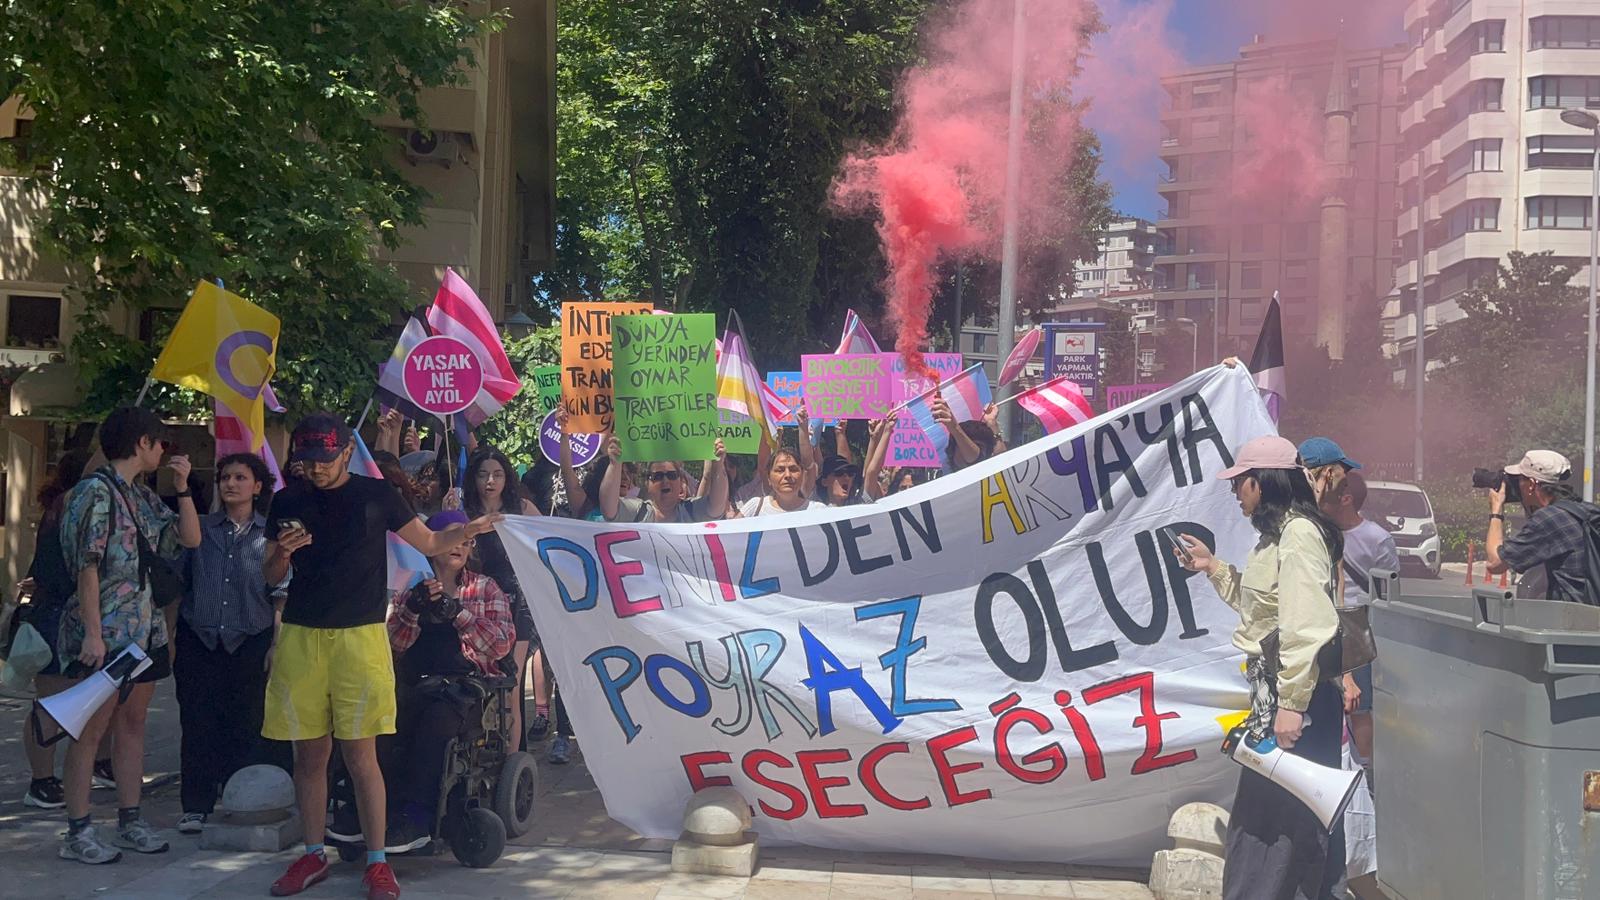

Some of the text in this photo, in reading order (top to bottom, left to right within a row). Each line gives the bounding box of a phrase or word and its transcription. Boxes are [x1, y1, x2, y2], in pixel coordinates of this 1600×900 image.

[616, 317, 688, 348] DÜNYA
[412, 353, 472, 371] YASAK
[628, 338, 713, 366] YERİNDEN
[1063, 355, 1086, 363] PARK
[630, 366, 692, 388] OYNAR
[1056, 364, 1092, 372] YAPMAK
[431, 372, 455, 388] NE
[424, 389, 464, 404] AYOL
[615, 391, 718, 421] TRAVESTİLER
[627, 421, 717, 442] ÖZGÜR OLSA
[894, 432, 926, 444] OLMA
[544, 427, 591, 458] AHLKSIZ
[582, 521, 1216, 743] POYRAZ OLUP
[680, 671, 1198, 820] ESECEĞİZ
